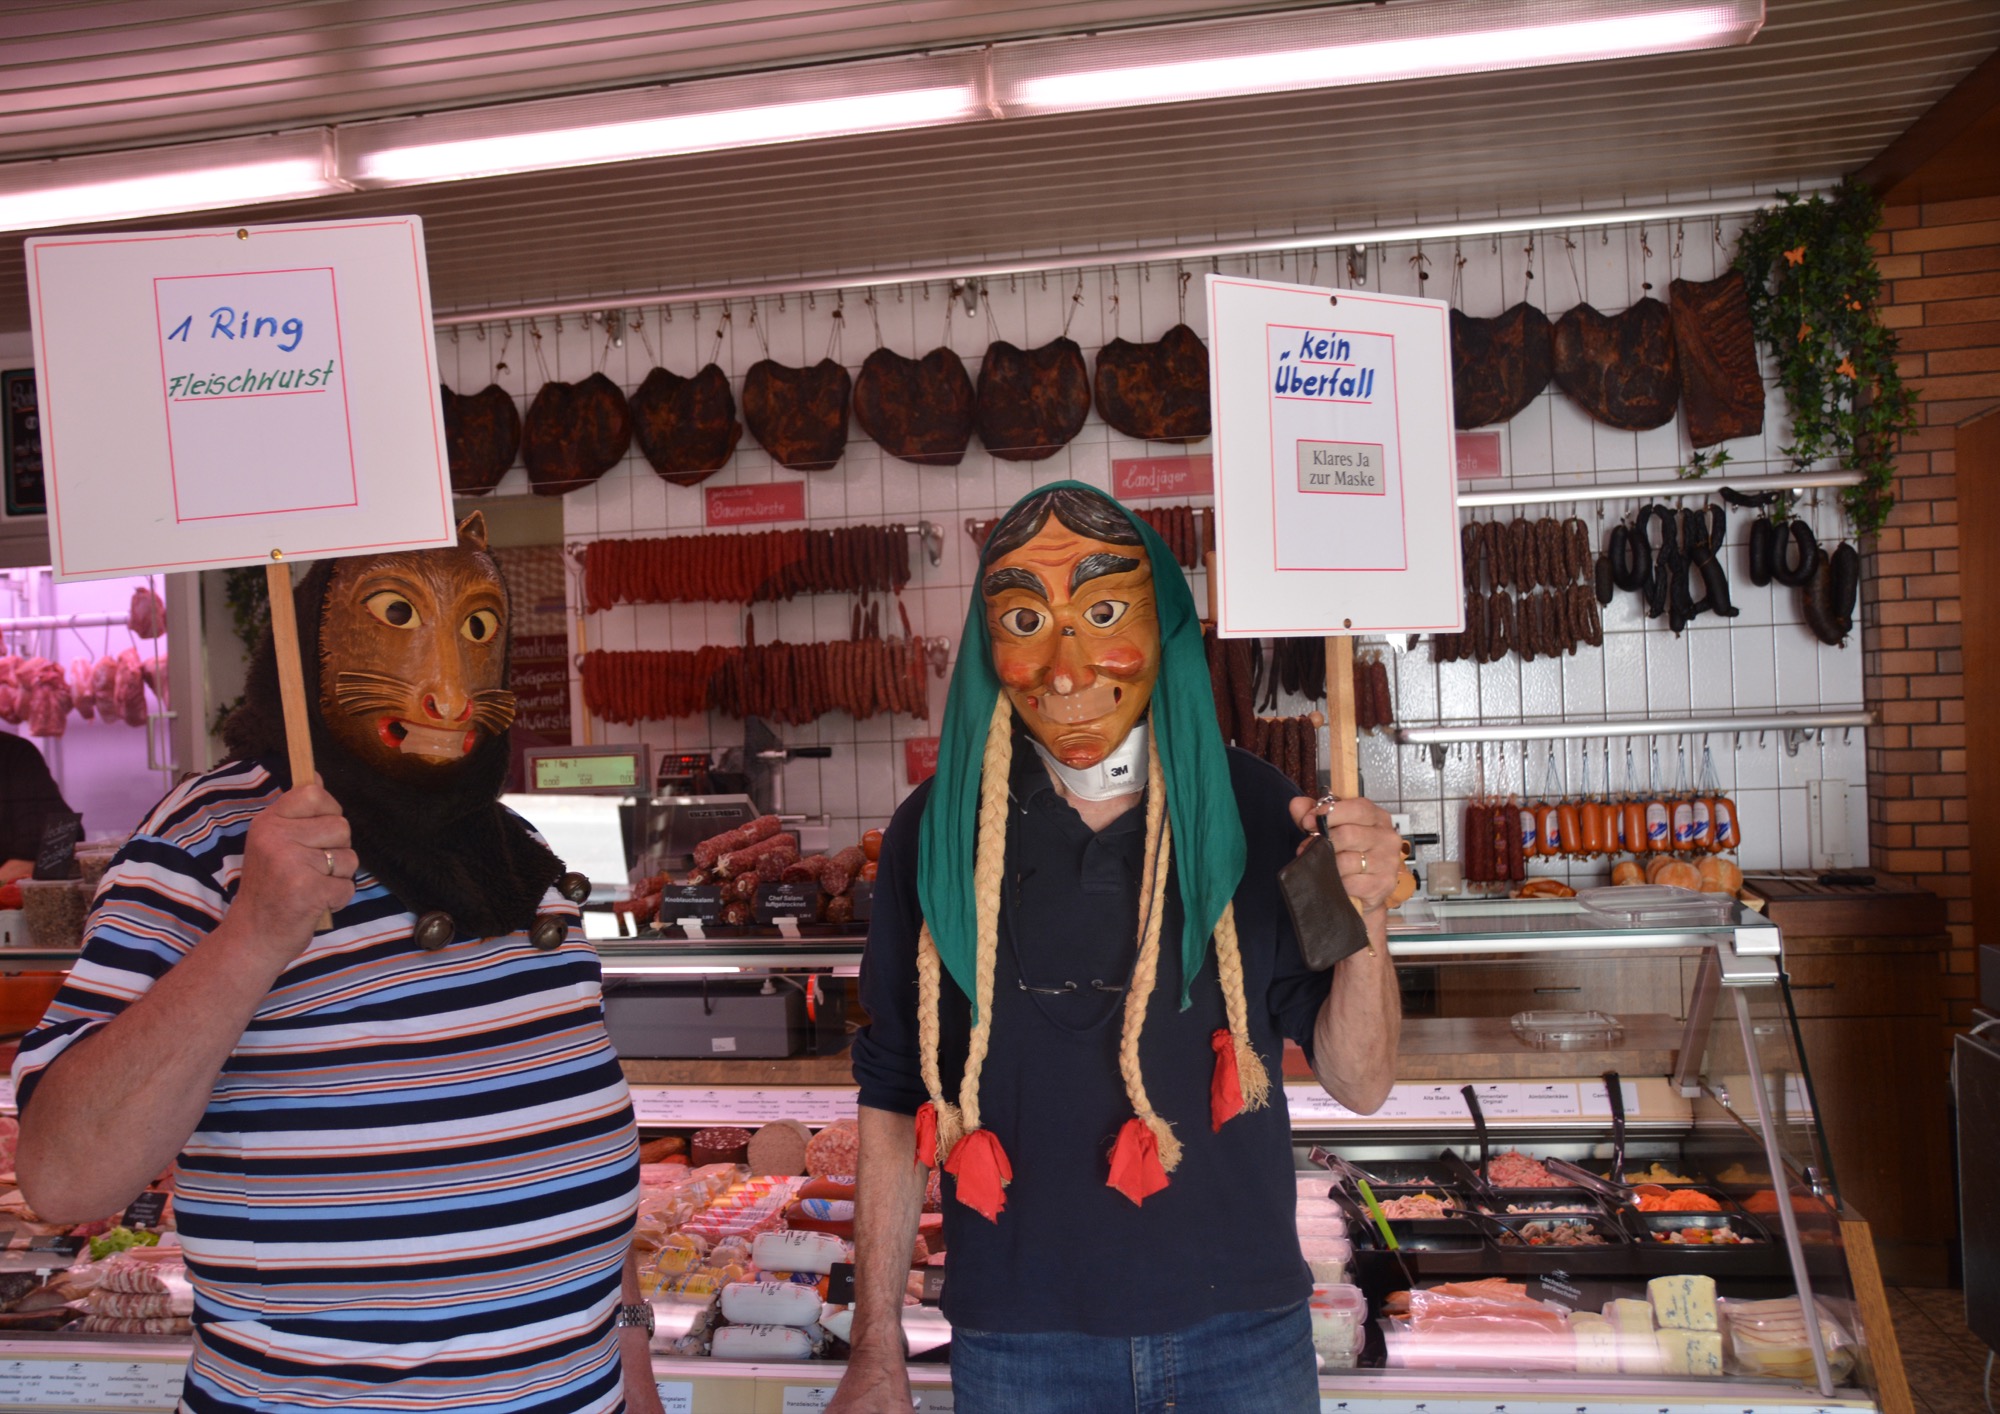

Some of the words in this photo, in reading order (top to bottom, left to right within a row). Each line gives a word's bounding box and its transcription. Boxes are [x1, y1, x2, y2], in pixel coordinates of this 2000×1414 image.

[167, 314, 193, 342] 1
[209, 306, 303, 352] Ring
[1299, 330, 1350, 361] kein
[168, 359, 335, 397] Fleischwurst
[1274, 350, 1375, 399] Überfall
[1313, 449, 1353, 467] Klares
[1355, 452, 1371, 468] Ja
[1122, 464, 1188, 492] Landjäger
[1309, 472, 1331, 486] zur
[1334, 470, 1376, 488] Maske
[711, 500, 786, 519] Bauernwürste
[1110, 764, 1129, 777] 3M
[664, 896, 715, 904] Knoblauchsalami
[764, 901, 807, 909] luftgetrocknet
